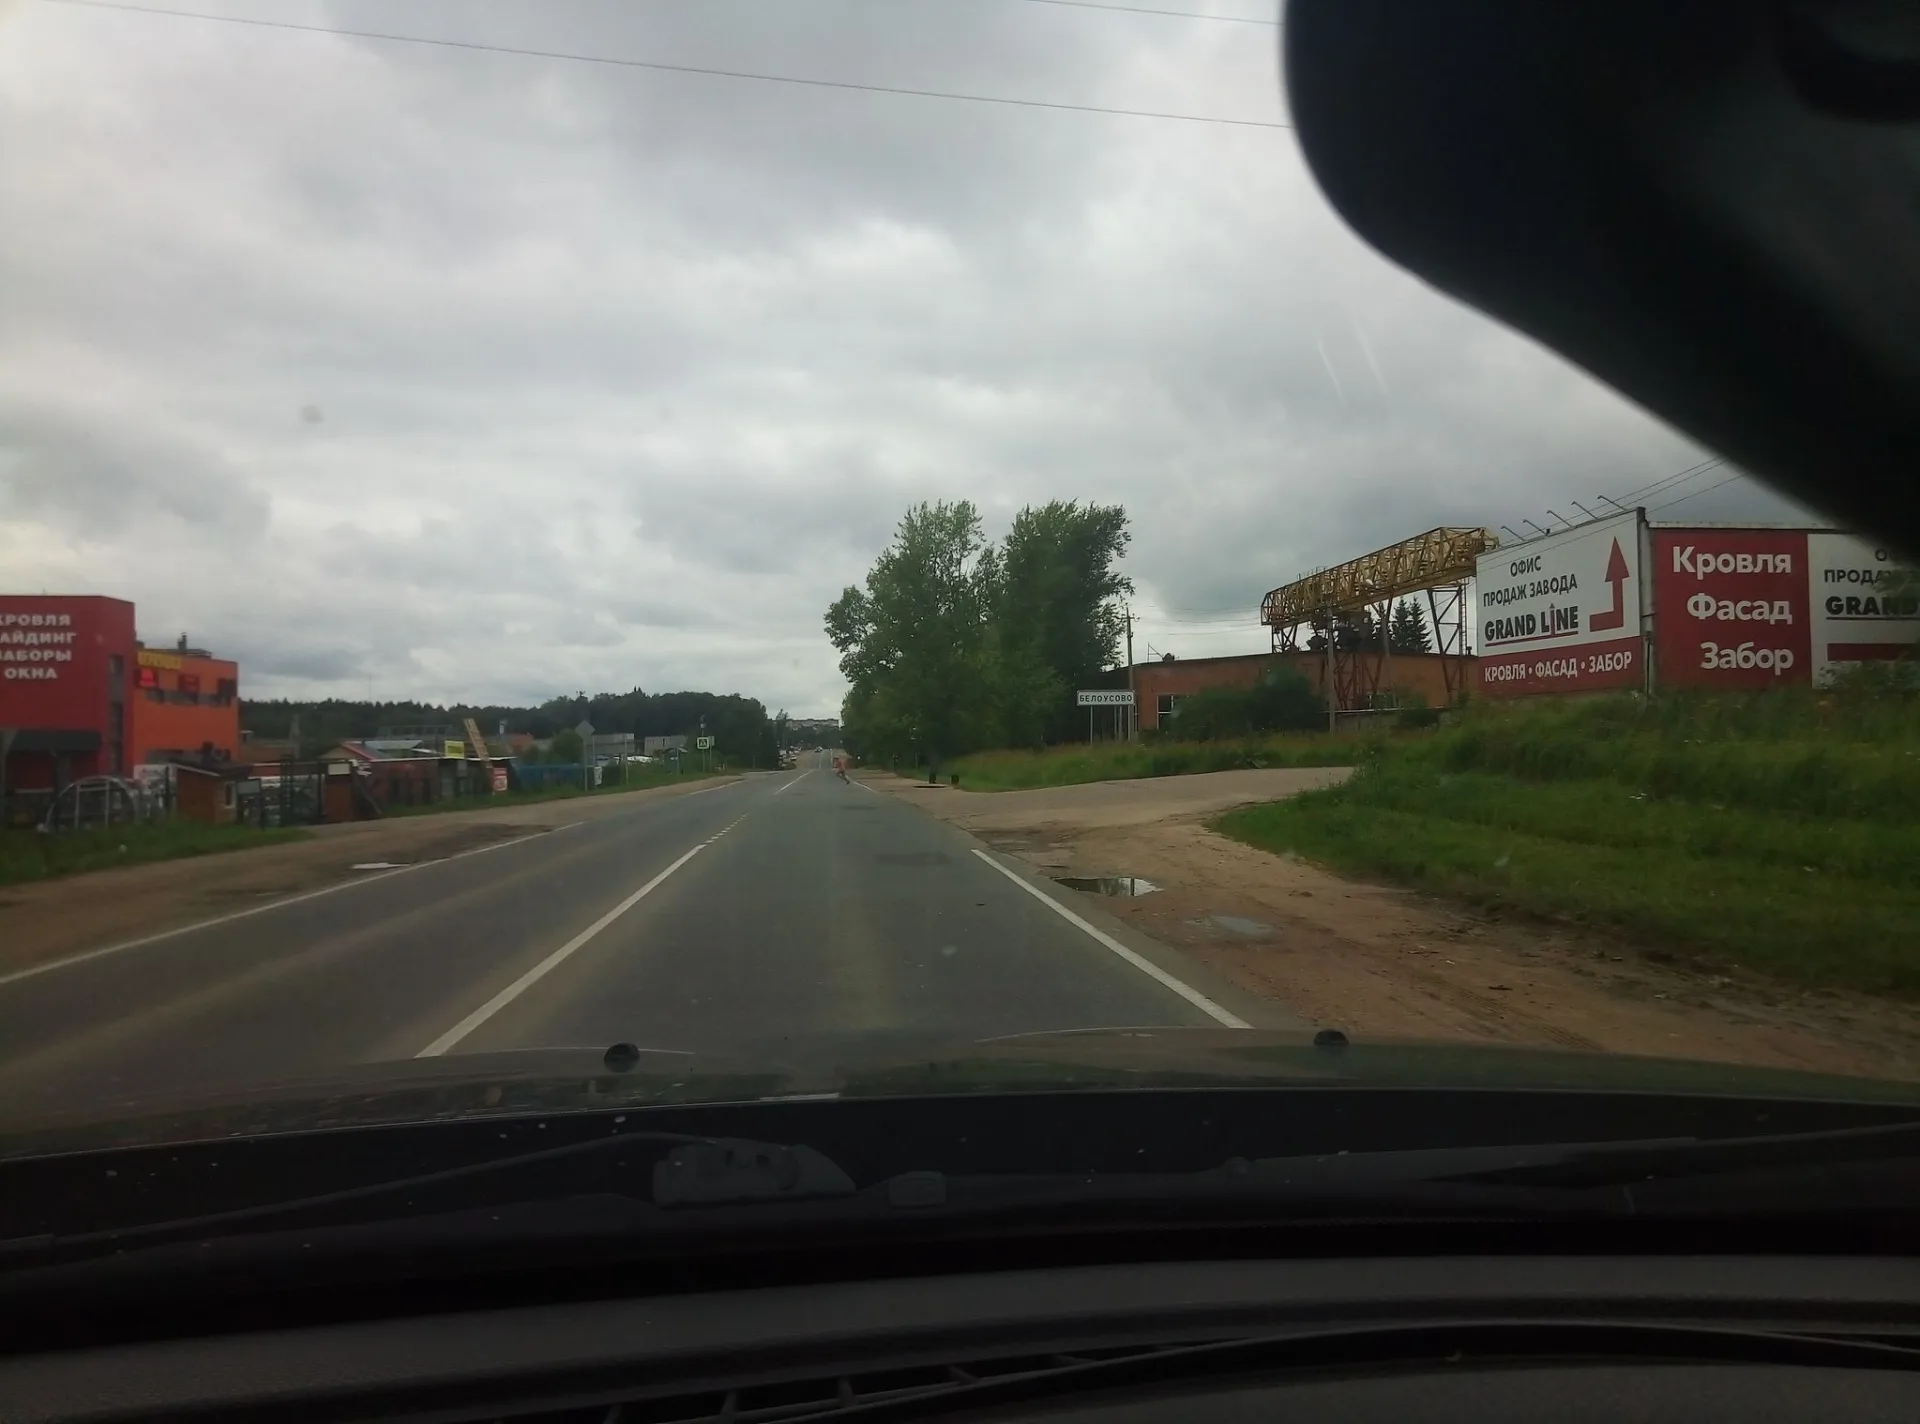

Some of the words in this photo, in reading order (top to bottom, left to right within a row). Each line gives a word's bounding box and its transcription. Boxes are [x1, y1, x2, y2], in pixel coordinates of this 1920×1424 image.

[1510, 556, 1541, 577] ОФИС
[1673, 546, 1792, 580] Кровля
[1483, 584, 1527, 607] ПРОДАЖ
[1530, 574, 1578, 598] ЗАВОДА
[1824, 569, 1894, 585] ПРОДА
[1686, 592, 1793, 625] Фасад
[0, 630, 77, 646] АЙДИНГ
[1485, 614, 1536, 641] GRAND
[0, 649, 72, 661] АБОРЫ
[1485, 664, 1526, 682] КРОВЛЯ
[1535, 658, 1578, 679] ФАСАД
[1589, 651, 1632, 673] ЗАБОР
[1701, 641, 1794, 676] Забор
[4, 668, 58, 679] ОКНА
